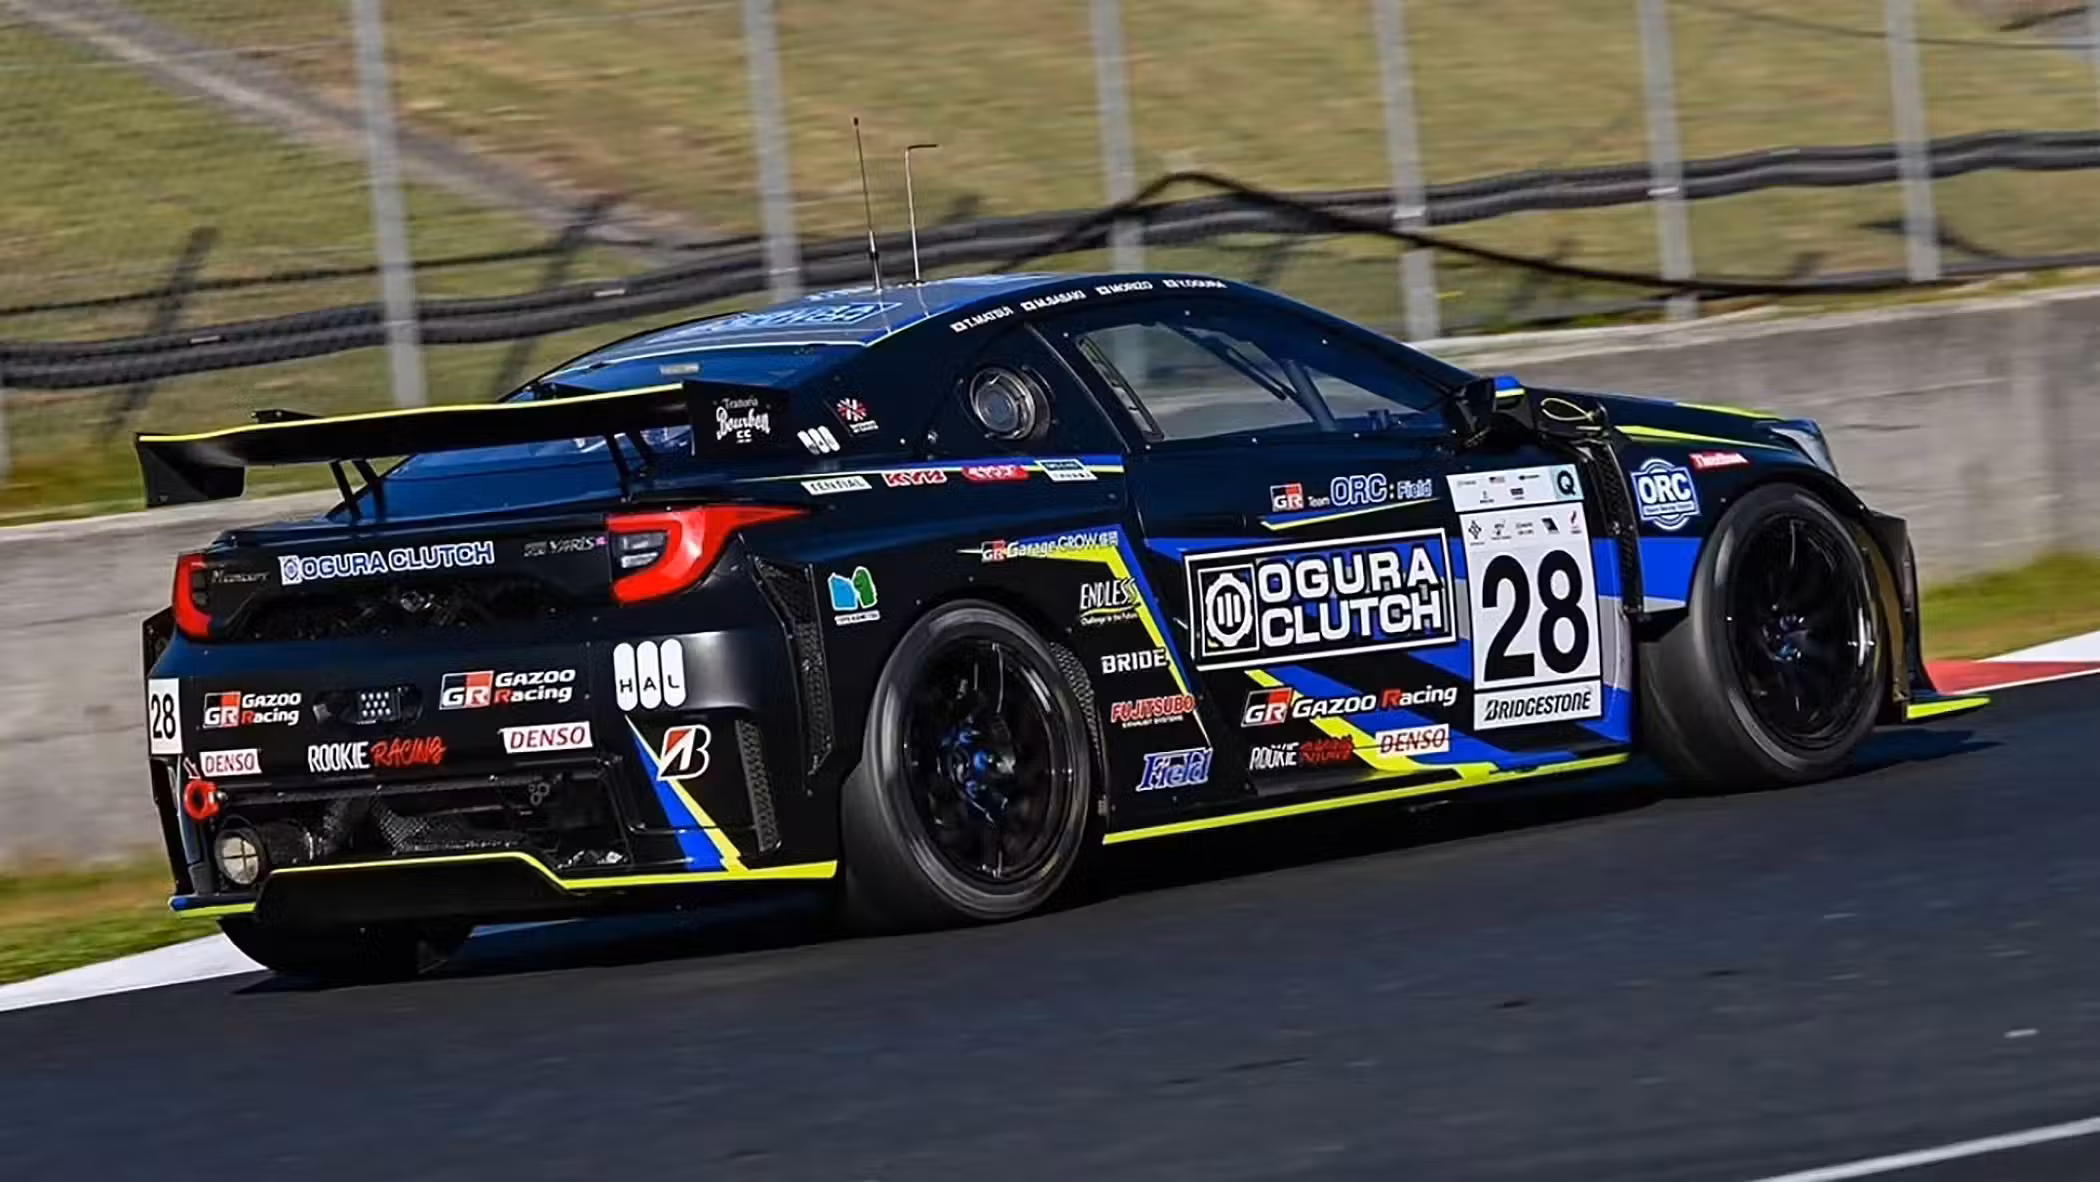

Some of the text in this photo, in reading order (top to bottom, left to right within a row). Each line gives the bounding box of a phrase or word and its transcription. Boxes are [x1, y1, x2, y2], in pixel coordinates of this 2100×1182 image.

[1108, 280, 1153, 295] MORIZO
[963, 306, 1014, 328] T.MATSUI
[1273, 494, 1303, 510] GR
[1396, 478, 1433, 500] Field
[1556, 470, 1577, 496] Q
[1637, 472, 1692, 505] ORC
[300, 550, 389, 581] OGURA
[388, 540, 496, 572] CLUTCH
[981, 548, 1006, 562] GR
[1006, 540, 1057, 559] Garage
[1057, 532, 1099, 550] GROW
[1257, 547, 1439, 604] OGURA
[1079, 577, 1140, 611] ENDLESS
[1260, 590, 1443, 648] CLUTCH
[1481, 549, 1590, 682] 28
[1100, 648, 1168, 674] BRIDE
[441, 669, 576, 707] GR GAZOO
[494, 685, 573, 704] Racing
[619, 674, 681, 693] HAL
[151, 693, 177, 740] 28
[203, 692, 302, 727] GR GAZOO
[241, 707, 300, 726] Racing
[1110, 692, 1195, 723] FUJITSUBO
[1244, 684, 1458, 724] GR GAZOO Racing
[1484, 690, 1592, 722] BRIDGESTONE
[511, 726, 586, 750] DENSO
[1379, 727, 1447, 755] DENSO
[204, 752, 256, 774] DENSO
[307, 736, 447, 774] ROOKIE RACING
[1135, 747, 1213, 792] Field
[1249, 741, 1300, 771] ROOKIE
